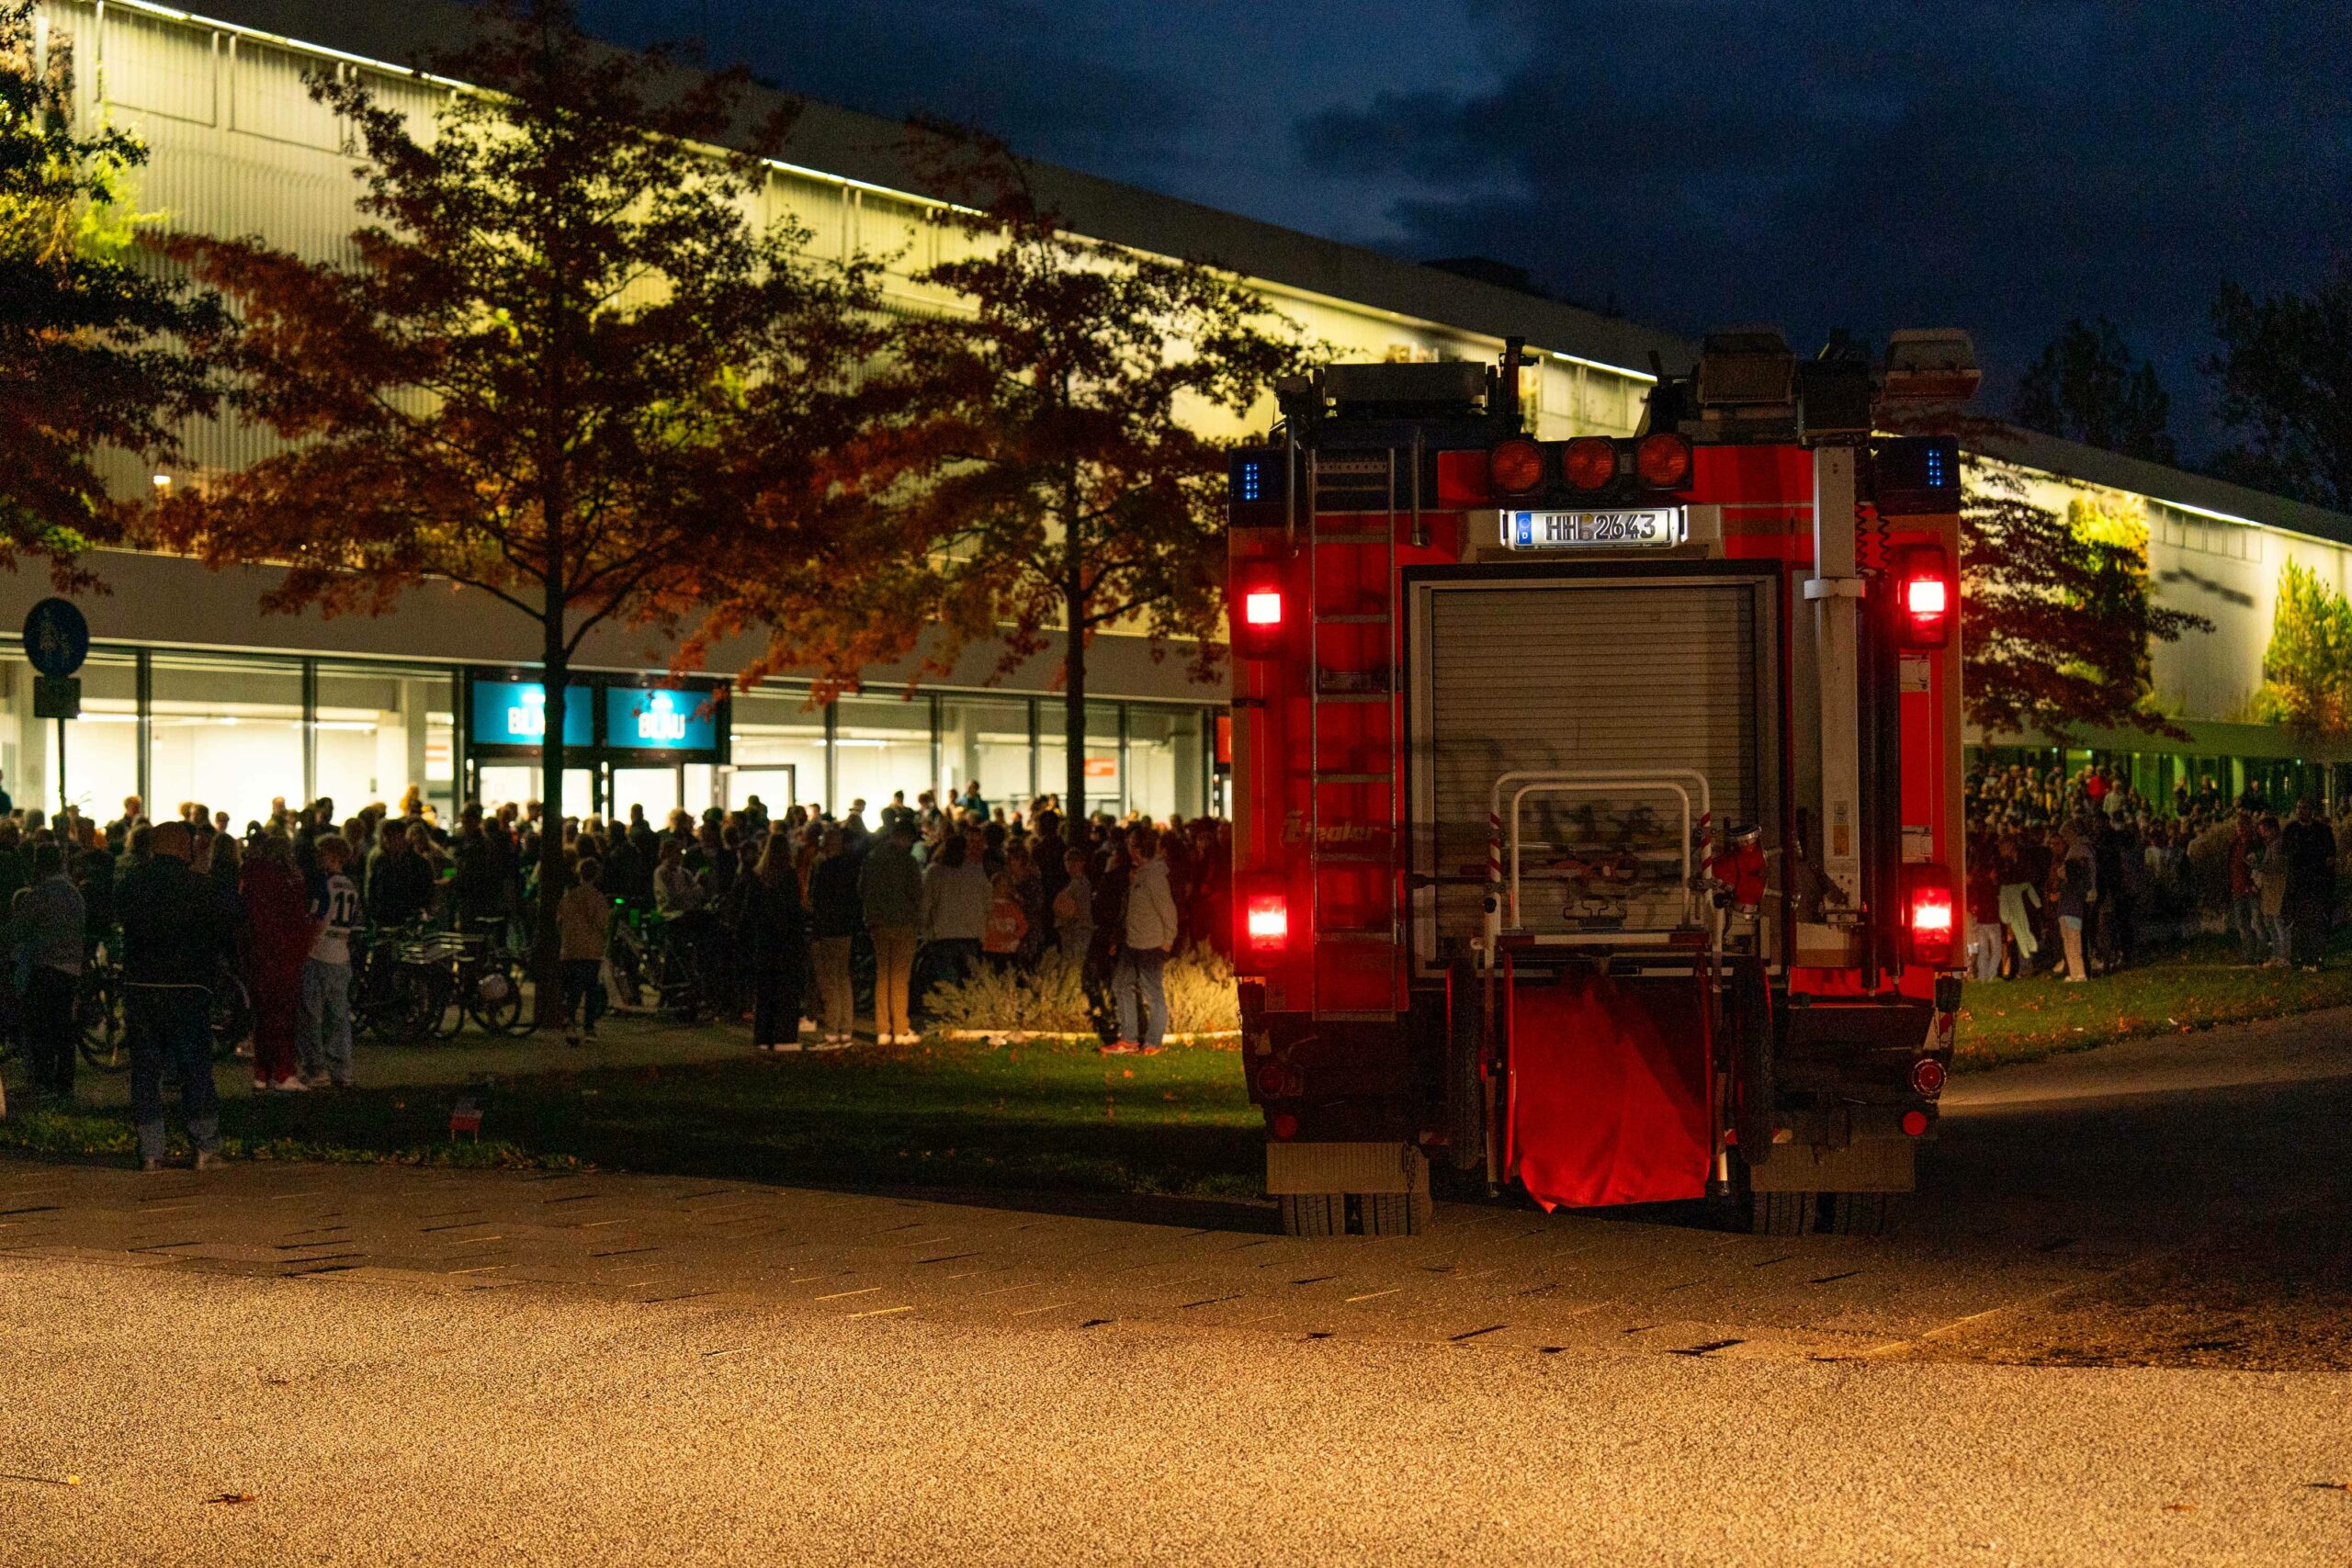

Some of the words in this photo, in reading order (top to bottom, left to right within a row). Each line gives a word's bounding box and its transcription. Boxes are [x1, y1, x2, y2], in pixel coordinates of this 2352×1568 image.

[1521, 532, 1529, 540] D
[1545, 515, 1579, 541] HH
[1595, 514, 1656, 540] 2643
[508, 706, 546, 735] BLA
[639, 712, 685, 739] BLAU
